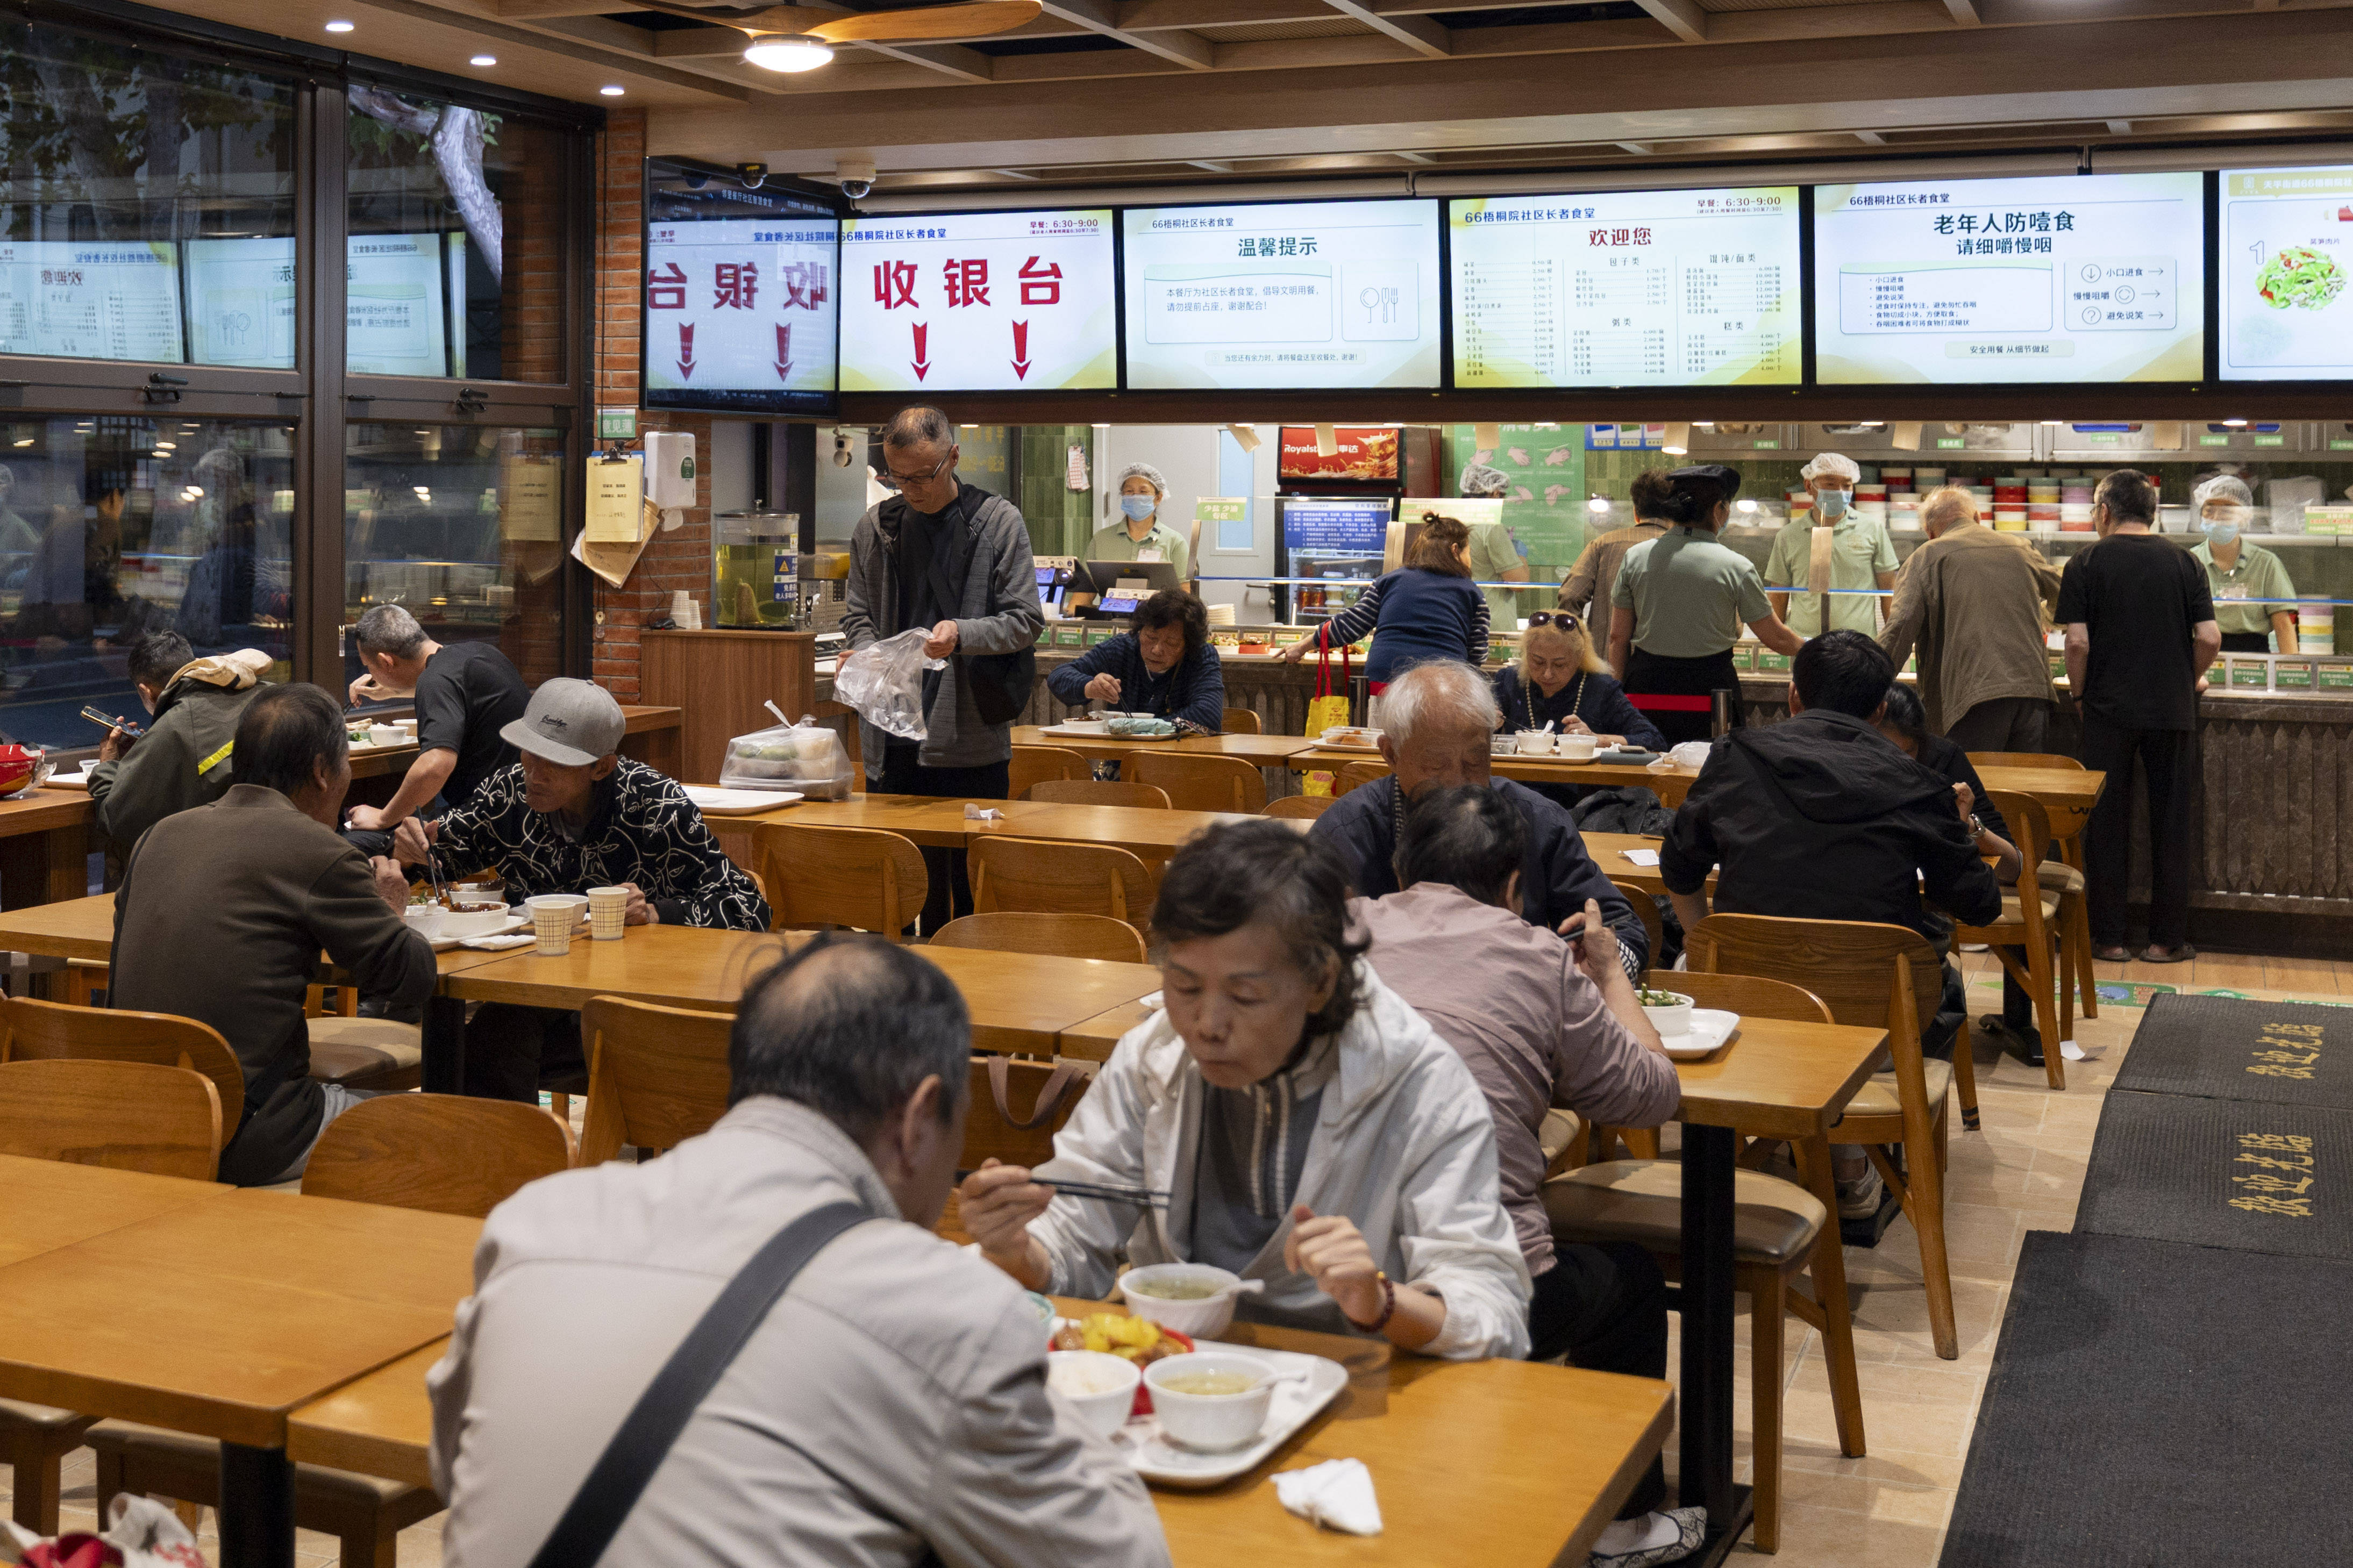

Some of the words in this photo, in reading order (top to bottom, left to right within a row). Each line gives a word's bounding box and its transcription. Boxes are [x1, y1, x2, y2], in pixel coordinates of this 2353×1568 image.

[1725, 196, 1781, 206] 6:30-9:00
[1849, 193, 1950, 206] 66梧桐社区长者食堂
[1464, 207, 1595, 223] 66梧桐院社区长者食堂
[1053, 218, 1099, 228] 6:30-9:00
[1152, 218, 1234, 229] 66梧桐社区长者食堂
[1934, 210, 2076, 235] 老年人防噎食
[840, 228, 947, 242] 66梧桐院社区长者食堂
[1589, 227, 1652, 247] 欢迎您
[1237, 237, 1318, 257] 温馨提示
[1956, 237, 2052, 256] 请细嚼慢咽
[2106, 267, 2143, 277] 小口进食
[873, 255, 1064, 310] 收银台
[1166, 285, 1320, 297] 本餐厅为社区长者食堂，倡导文明用餐，
[2073, 291, 2110, 301] 慢慢咀嚼
[1167, 300, 1268, 312] 请勿提前占座，谢谢配合！
[2106, 311, 2144, 321] 避免说笑
[1969, 345, 2003, 354] 安全用餐
[2006, 344, 2050, 354] 从细节做起
[1284, 444, 1317, 455] Royalst
